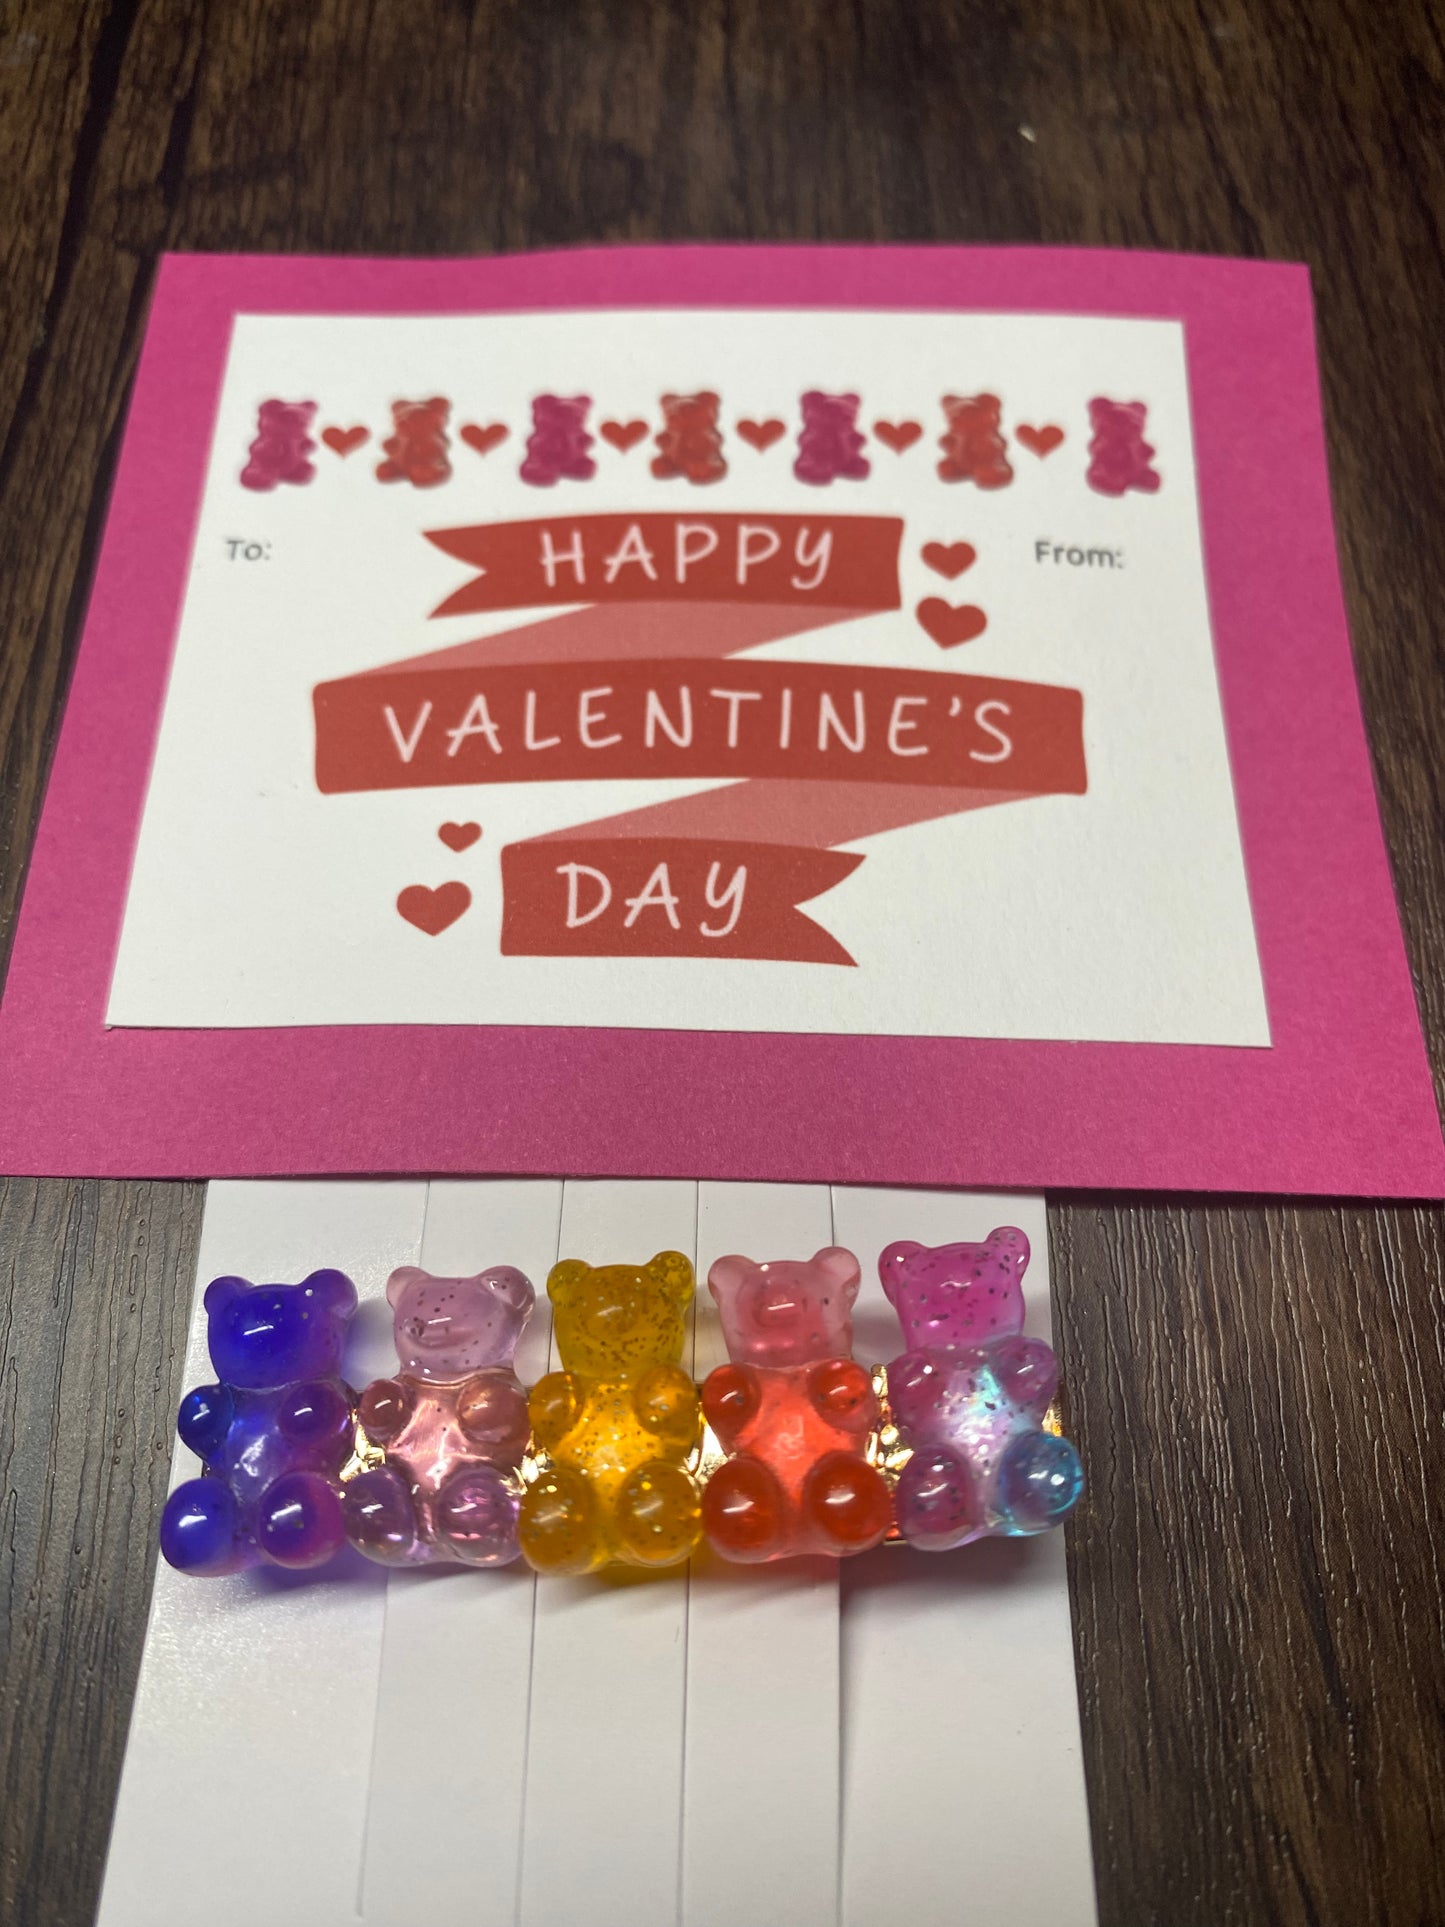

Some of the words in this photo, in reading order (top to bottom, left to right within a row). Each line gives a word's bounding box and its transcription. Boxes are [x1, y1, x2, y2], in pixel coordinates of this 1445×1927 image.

[224, 537, 272, 562] To:
[540, 523, 834, 591] HAPPY
[1034, 539, 1124, 570] From:
[383, 686, 1012, 763] VALENTINE'S
[556, 861, 747, 938] DAY
